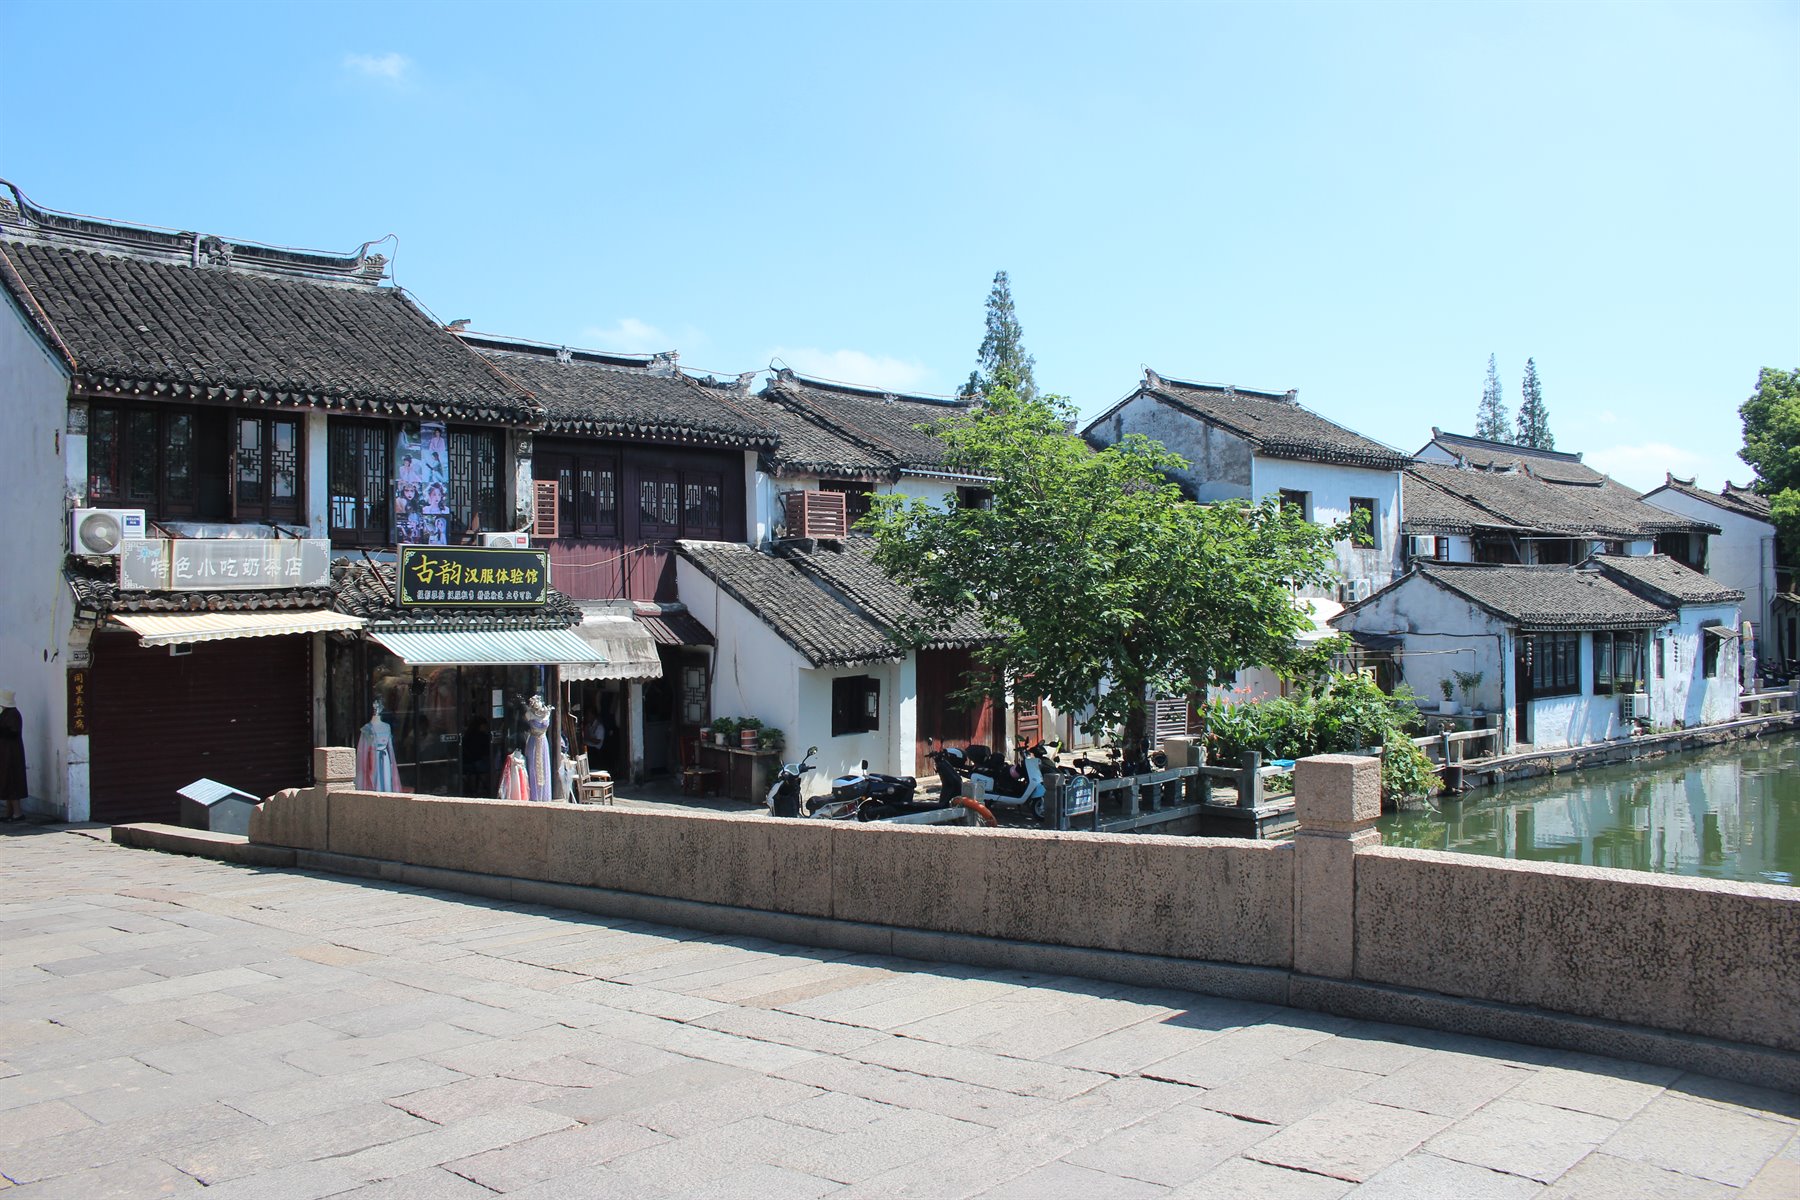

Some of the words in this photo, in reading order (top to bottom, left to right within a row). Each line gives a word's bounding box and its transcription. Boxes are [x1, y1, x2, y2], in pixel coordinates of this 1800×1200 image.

[150, 557, 303, 579] 特色小吃奶茶店
